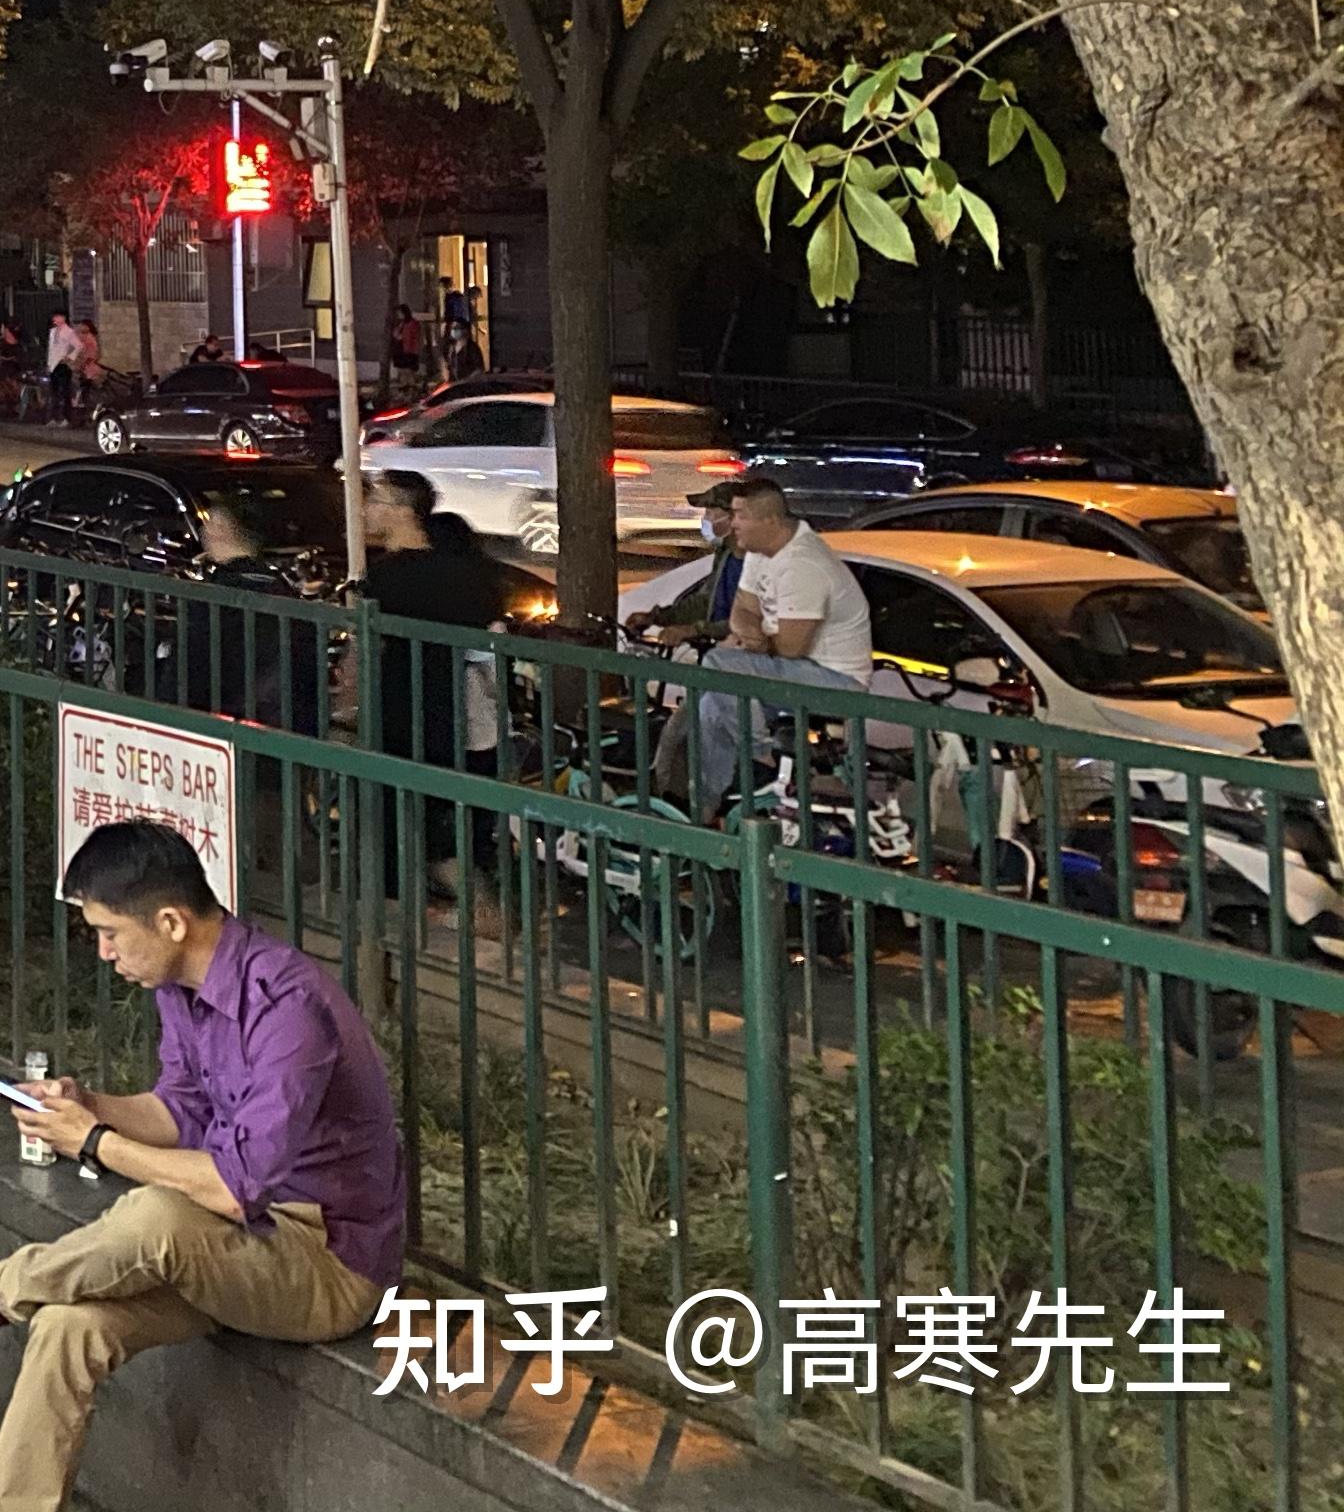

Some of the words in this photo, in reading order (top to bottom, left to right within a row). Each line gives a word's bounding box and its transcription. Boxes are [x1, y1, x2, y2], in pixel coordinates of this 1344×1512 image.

[73, 732, 105, 775] THE
[116, 743, 174, 792] STEPS
[182, 759, 218, 806] BAR
